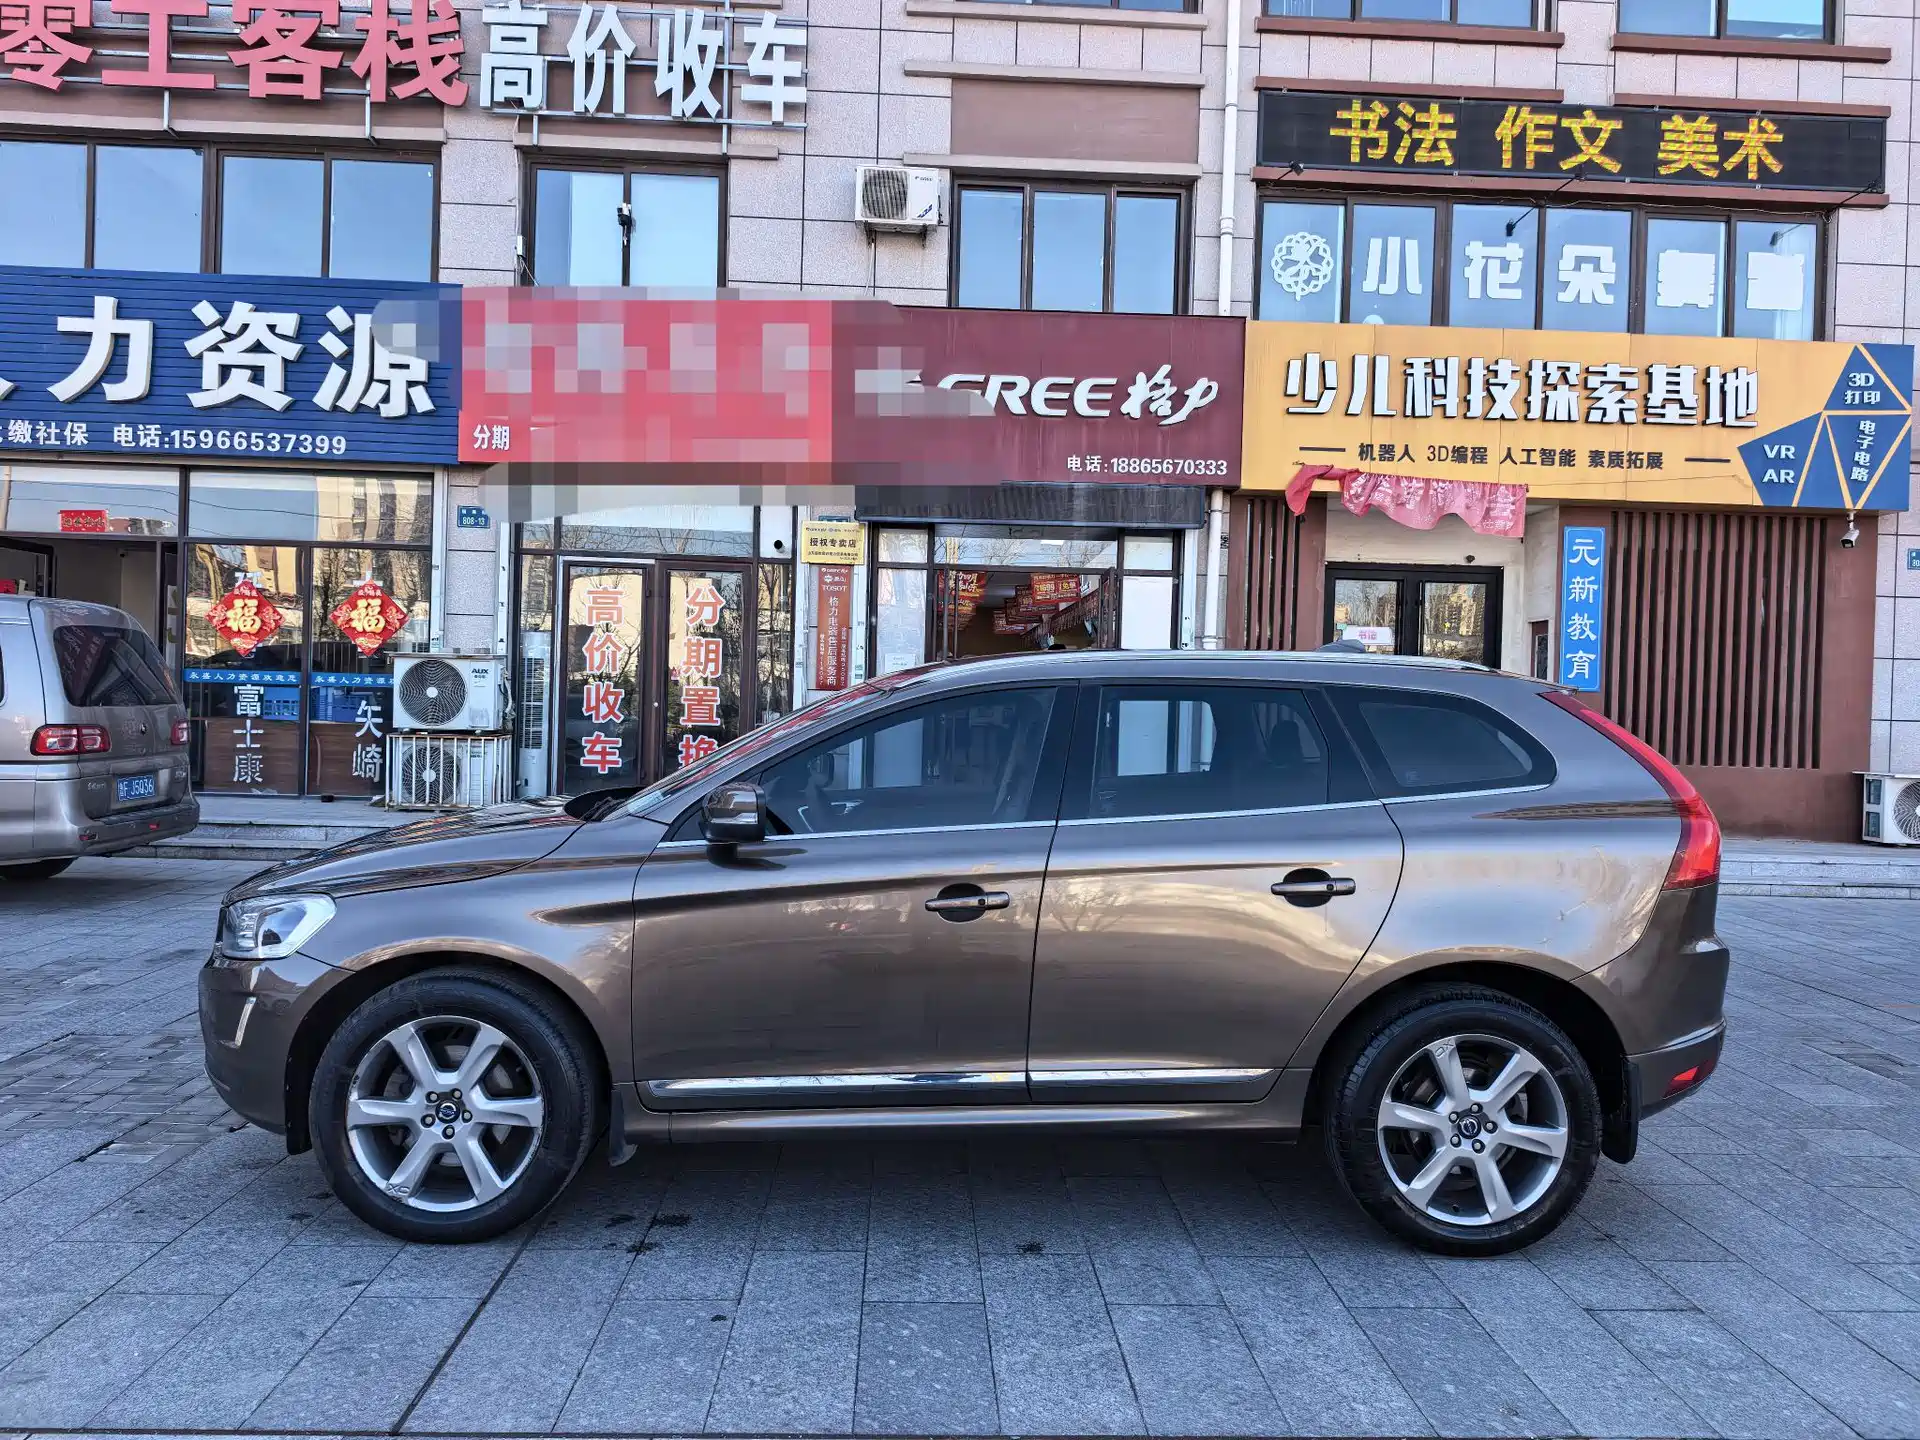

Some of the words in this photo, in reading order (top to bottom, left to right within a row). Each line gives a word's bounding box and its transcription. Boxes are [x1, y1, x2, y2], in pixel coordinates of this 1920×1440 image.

[0, 0, 469, 106] 零工客栈
[479, 0, 807, 125] 高价收车
[1329, 99, 1457, 166] 书法
[1494, 105, 1622, 173] 作文
[1657, 114, 1784, 180] 美术
[0, 295, 437, 418] 力资源
[1848, 373, 1875, 387] 3D
[1285, 352, 1758, 428] 少儿科技探索基地
[1844, 390, 1880, 405] 打印
[0, 420, 89, 446] 缴社保
[473, 424, 510, 451] 分期
[1358, 443, 1416, 462] 机器人
[1427, 445, 1488, 465] 3D编程
[1499, 447, 1577, 468] 人工智能
[1588, 450, 1664, 470] 素质拓展
[1763, 444, 1795, 459] VR
[1850, 420, 1877, 482] 电子电路
[1762, 468, 1795, 484] AR
[809, 537, 857, 548] 授权专卖店
[226, 598, 262, 634] 福
[350, 598, 386, 634] 福
[1566, 538, 1600, 679] 元新教育
[580, 585, 625, 774] 高价收车
[232, 683, 265, 783] 富士康
[352, 699, 384, 783] 矢崎
